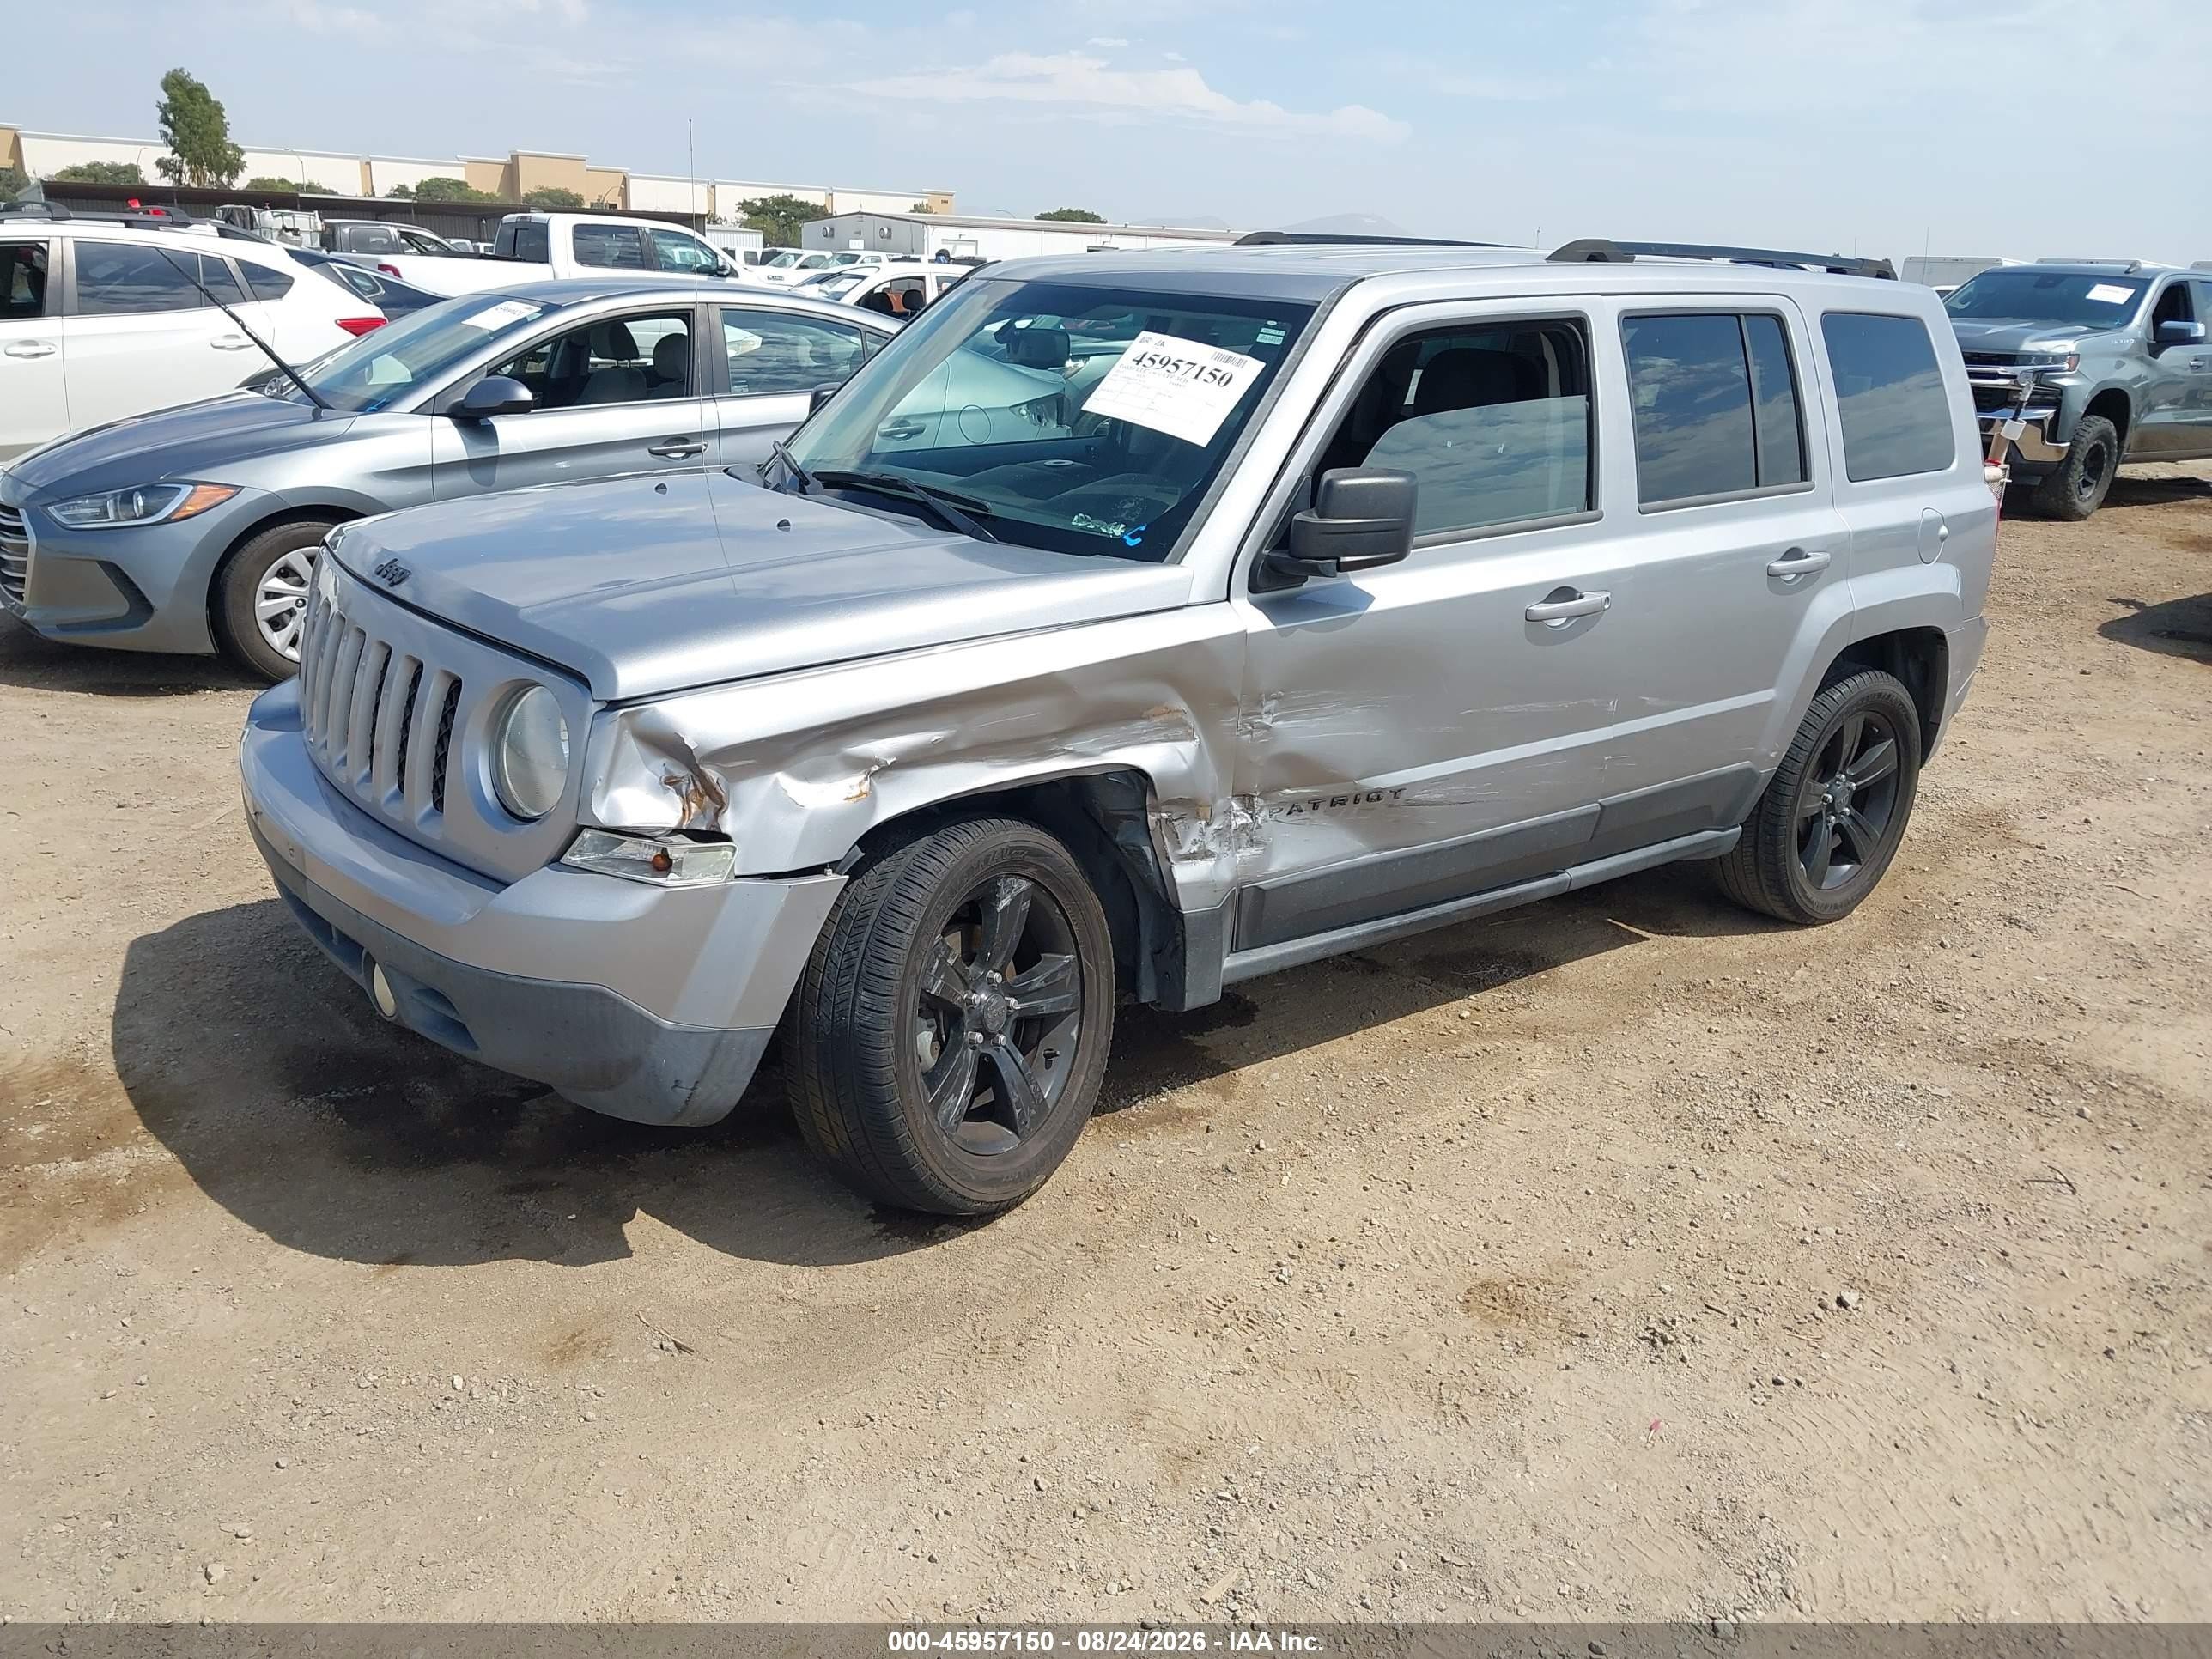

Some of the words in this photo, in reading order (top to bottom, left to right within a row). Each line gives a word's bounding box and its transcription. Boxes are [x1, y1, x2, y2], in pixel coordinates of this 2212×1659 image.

[1132, 351, 1234, 388] 45957150
[374, 558, 412, 587] Jeep
[1268, 787, 1407, 819] PATRIOT
